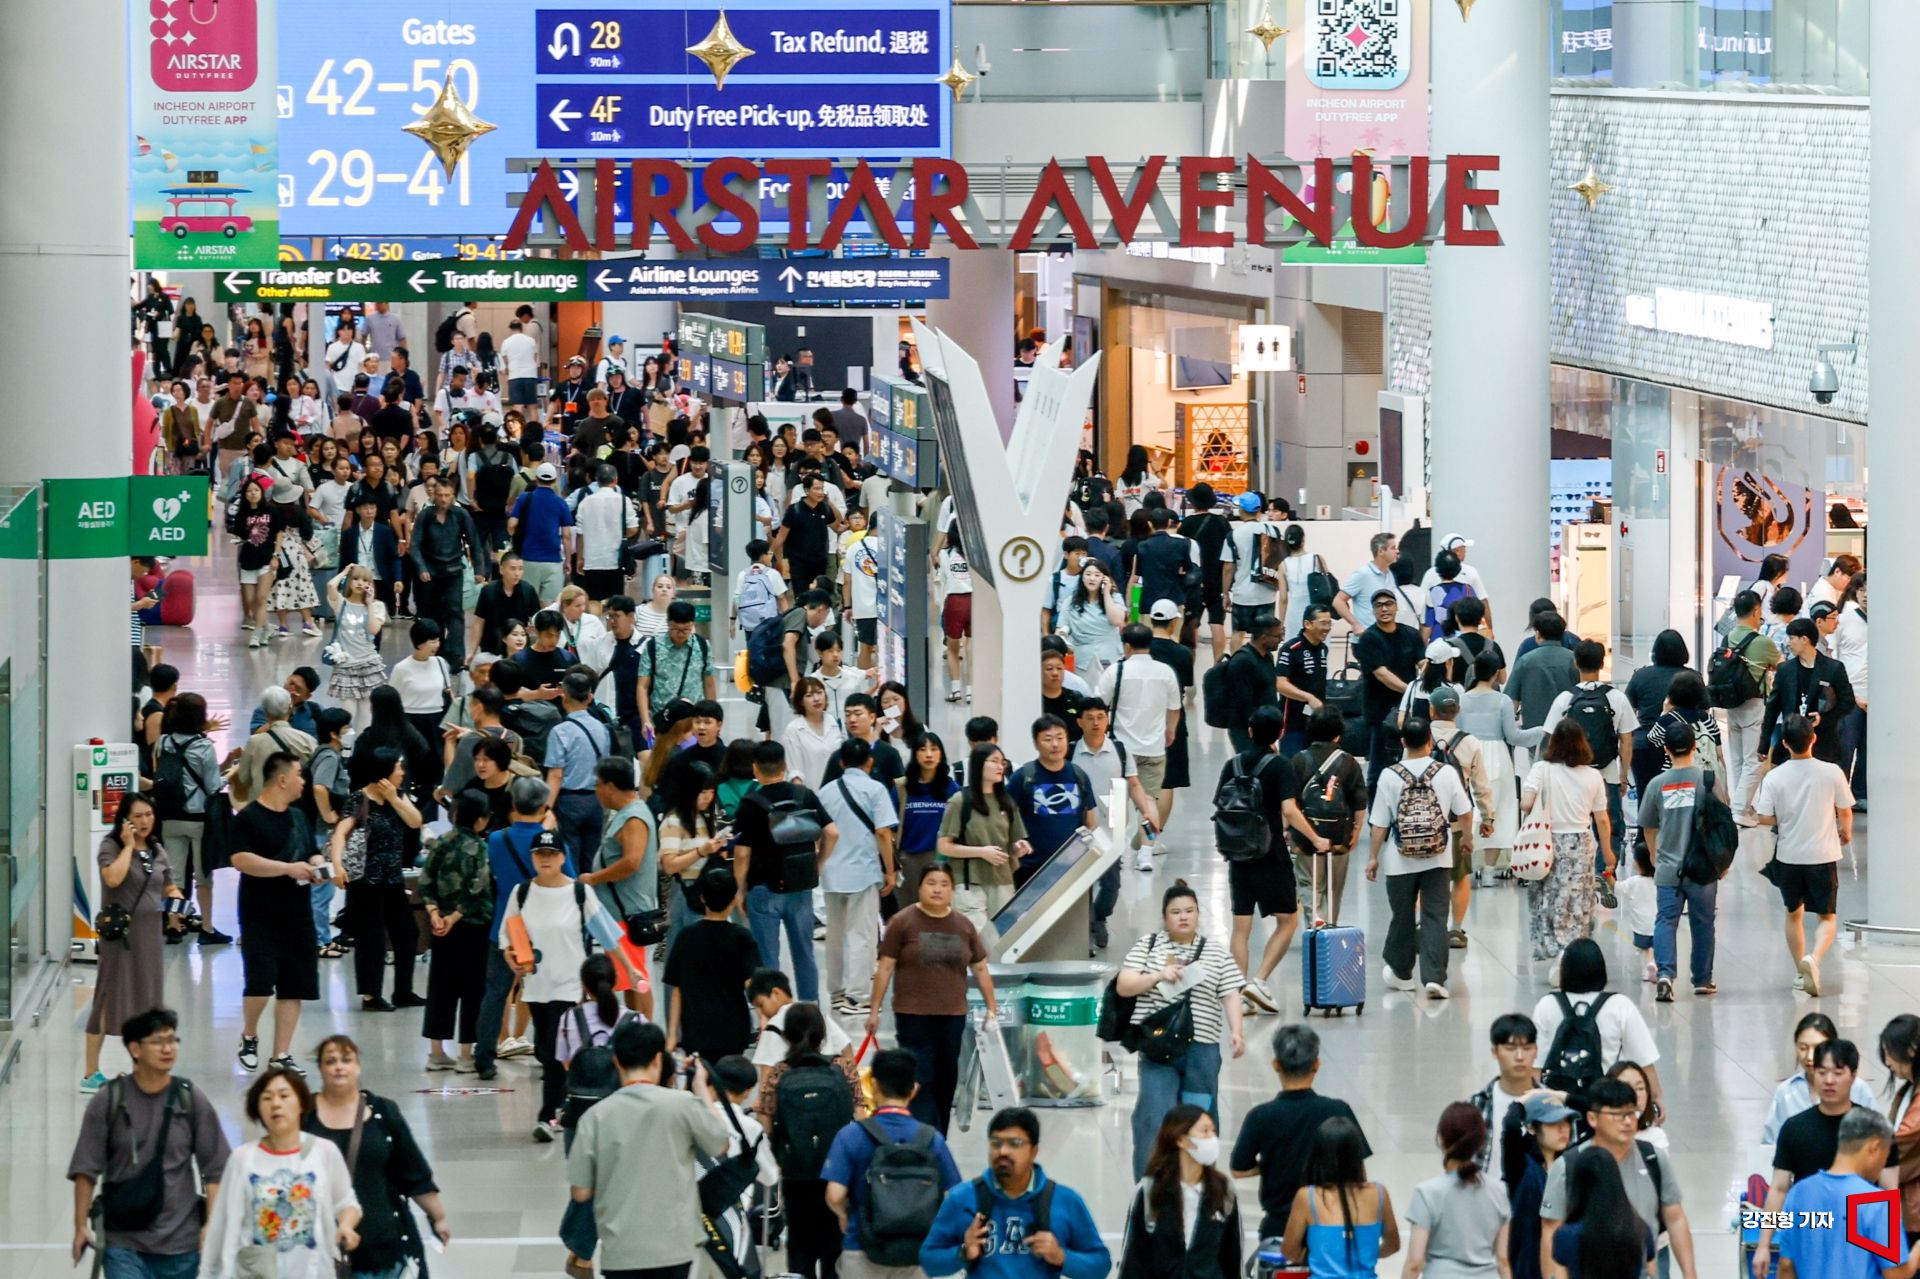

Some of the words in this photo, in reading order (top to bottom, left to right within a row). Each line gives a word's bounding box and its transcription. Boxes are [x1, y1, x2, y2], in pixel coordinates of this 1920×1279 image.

[402, 18, 476, 46] Gates
[590, 21, 621, 49] 28
[770, 31, 808, 53] Tax
[810, 30, 885, 55] Refund,
[889, 31, 928, 54] 退税
[167, 54, 242, 70] AIRSTAR
[589, 57, 612, 67] 90m
[154, 101, 205, 111] INCHEON
[208, 101, 256, 111] AIRPORT
[590, 96, 622, 123] 4F
[1306, 99, 1356, 109] INCHEON
[1359, 99, 1407, 109] AIRPORT
[163, 115, 221, 125] DUTYFREE
[224, 115, 247, 125] APP
[650, 106, 693, 132] Duty
[696, 106, 737, 127] Free
[740, 105, 815, 131] Pick-up,
[817, 104, 929, 128] 免税品领取处
[1315, 112, 1372, 122] DUTYFREE
[1375, 112, 1398, 122] APP
[590, 131, 612, 142] 10m
[501, 156, 980, 252] AIRSTAR
[1008, 153, 1500, 250] AVENUE
[194, 246, 236, 255] AIRSTAR
[346, 243, 403, 261] 42-50
[336, 267, 382, 284] Desk
[443, 269, 511, 289] Transfer
[514, 273, 578, 293] Lounge
[629, 266, 686, 282] Airline
[688, 267, 759, 286] Lounges
[257, 287, 288, 297] Other
[289, 287, 330, 297] Airlines
[657, 286, 688, 295] Airlines,
[689, 286, 728, 296] Singapore
[729, 286, 758, 294] Airlines
[78, 501, 115, 519] AED
[149, 527, 186, 541] AED
[106, 775, 129, 786] AED
